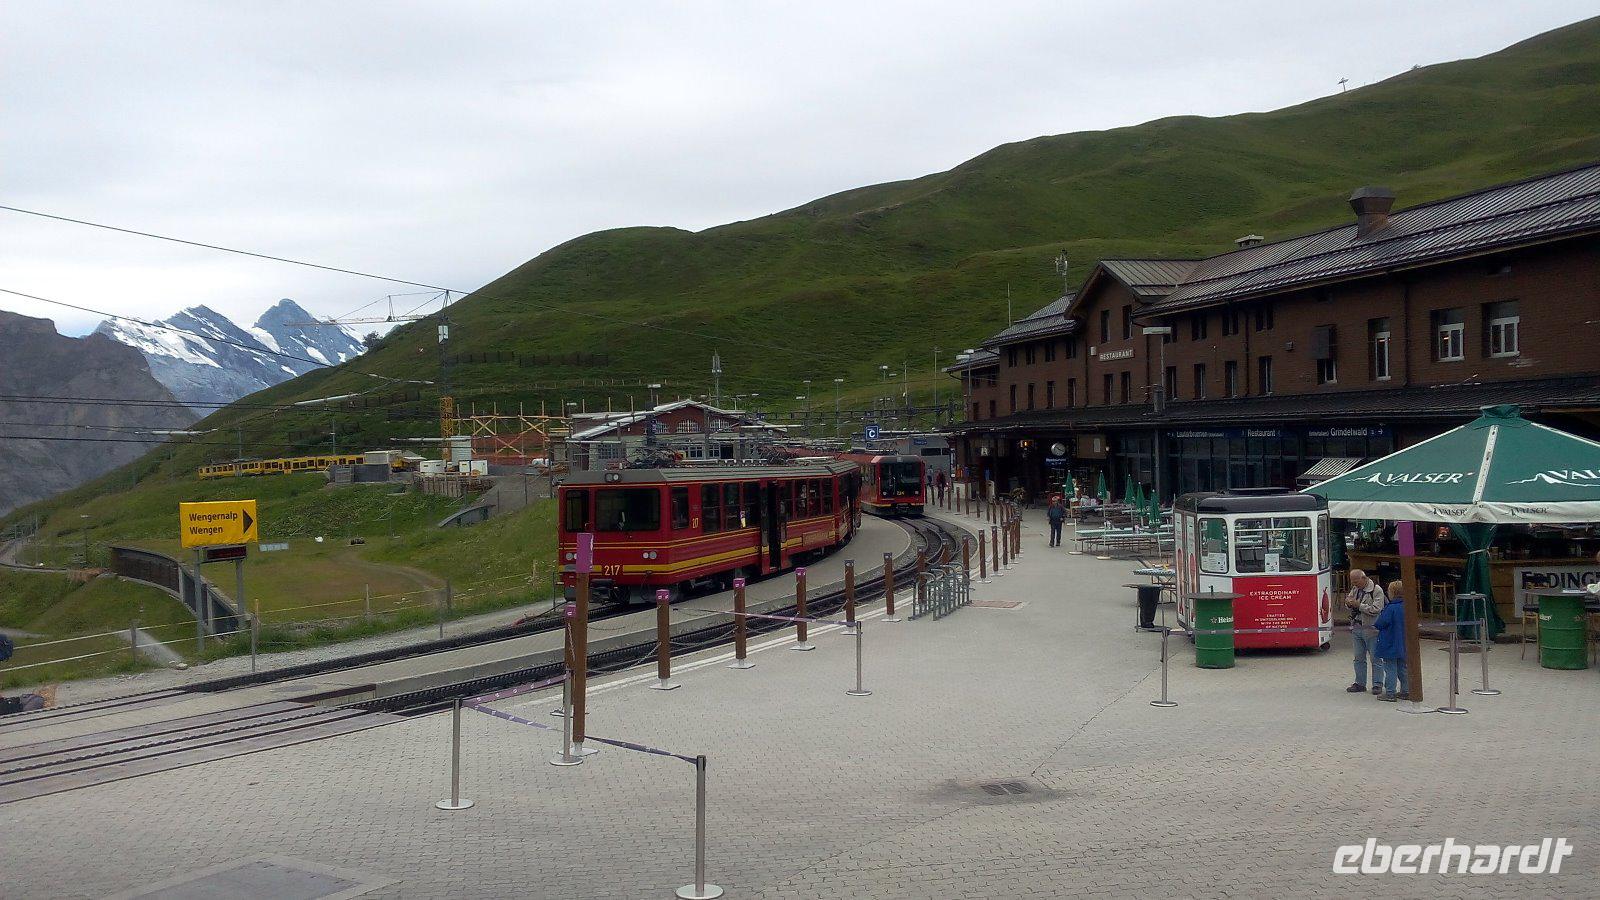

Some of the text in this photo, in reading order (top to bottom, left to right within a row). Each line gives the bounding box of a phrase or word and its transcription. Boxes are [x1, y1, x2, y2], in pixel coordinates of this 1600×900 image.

[1100, 349, 1133, 360] RESTAURANT
[868, 430, 876, 438] C
[1330, 427, 1368, 437] Grindelwald
[1386, 472, 1464, 484] VALSER
[1547, 469, 1600, 480] VAL
[189, 511, 238, 522] Wengernalp
[1440, 508, 1467, 516] VALSER
[189, 526, 223, 536] Wengen
[604, 564, 621, 576] 217
